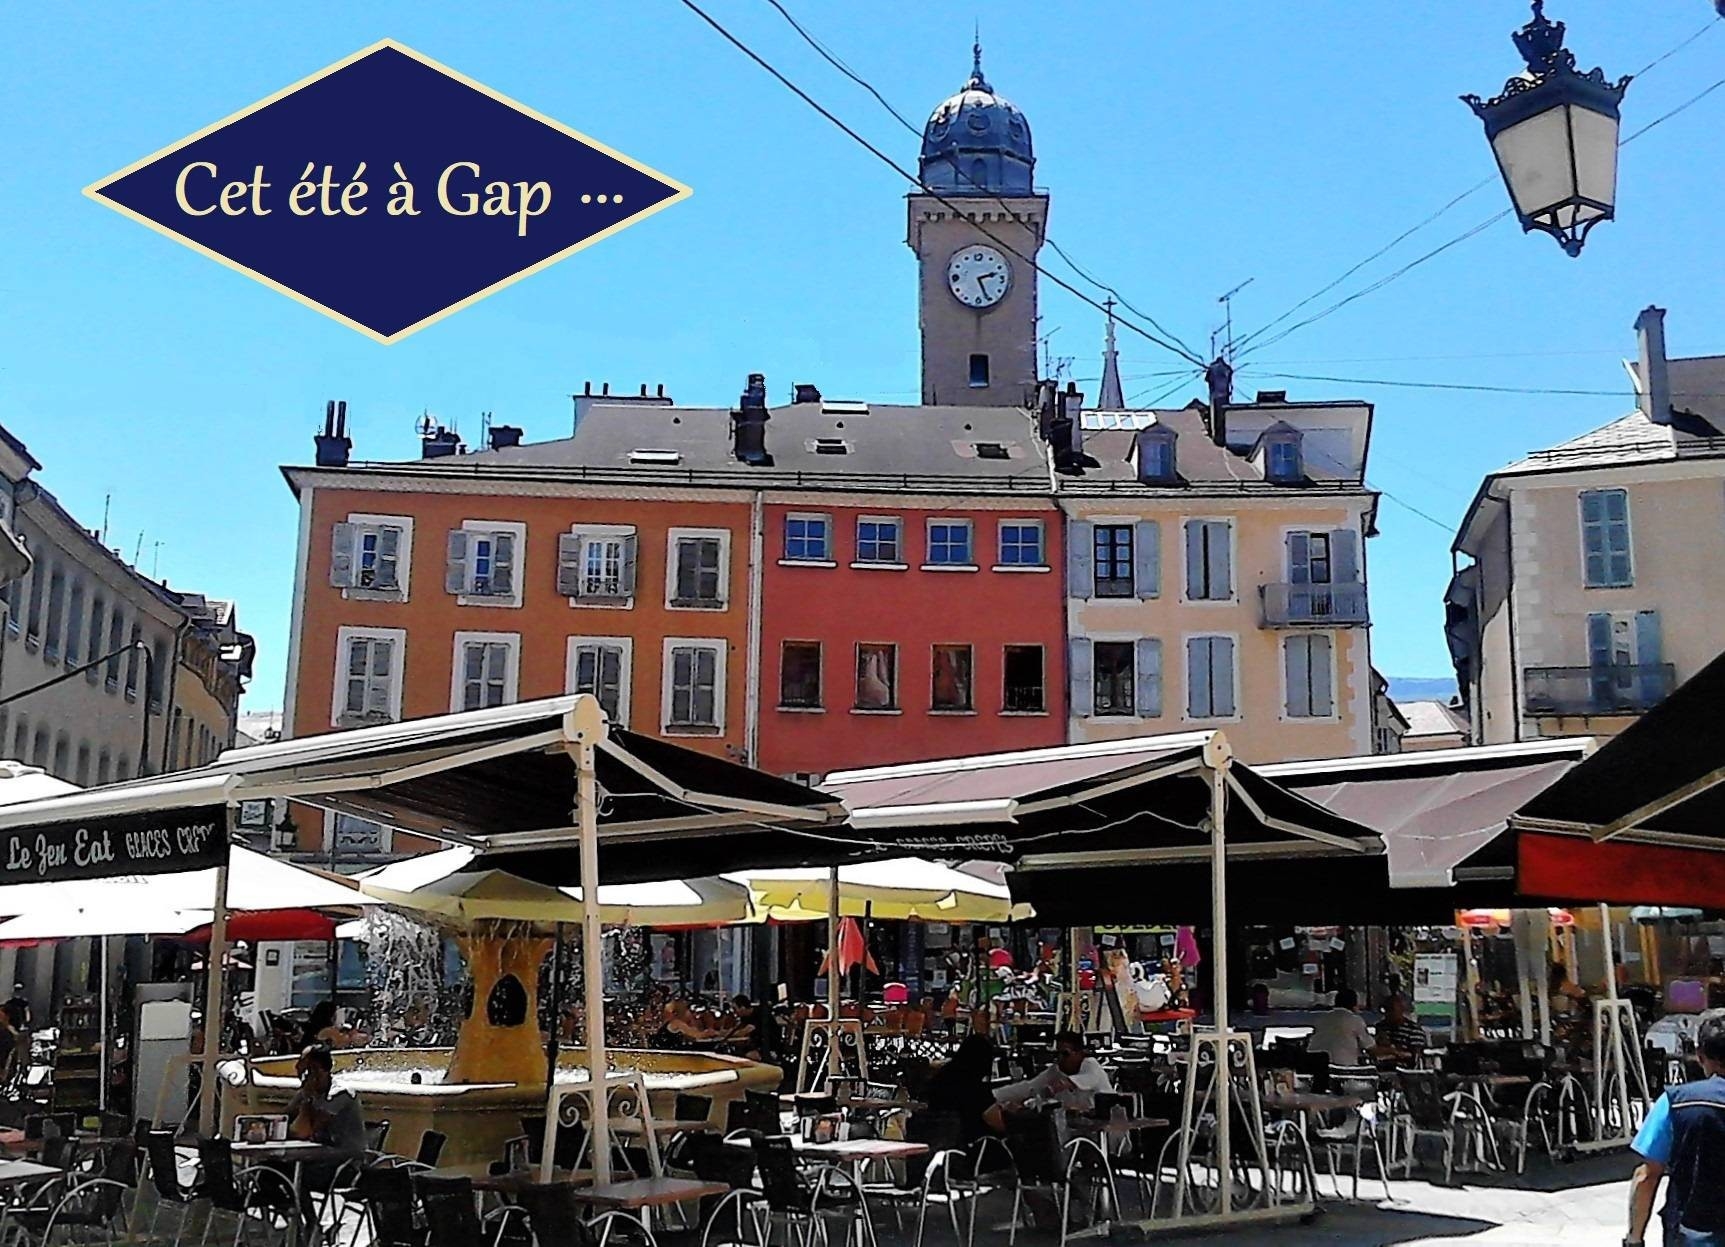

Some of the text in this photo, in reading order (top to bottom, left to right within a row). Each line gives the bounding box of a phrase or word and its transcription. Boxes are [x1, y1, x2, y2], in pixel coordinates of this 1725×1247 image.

[6, 836, 33, 871] Le
[35, 833, 68, 876] Zen
[74, 828, 115, 867] Eat
[125, 828, 172, 860] GLACES
